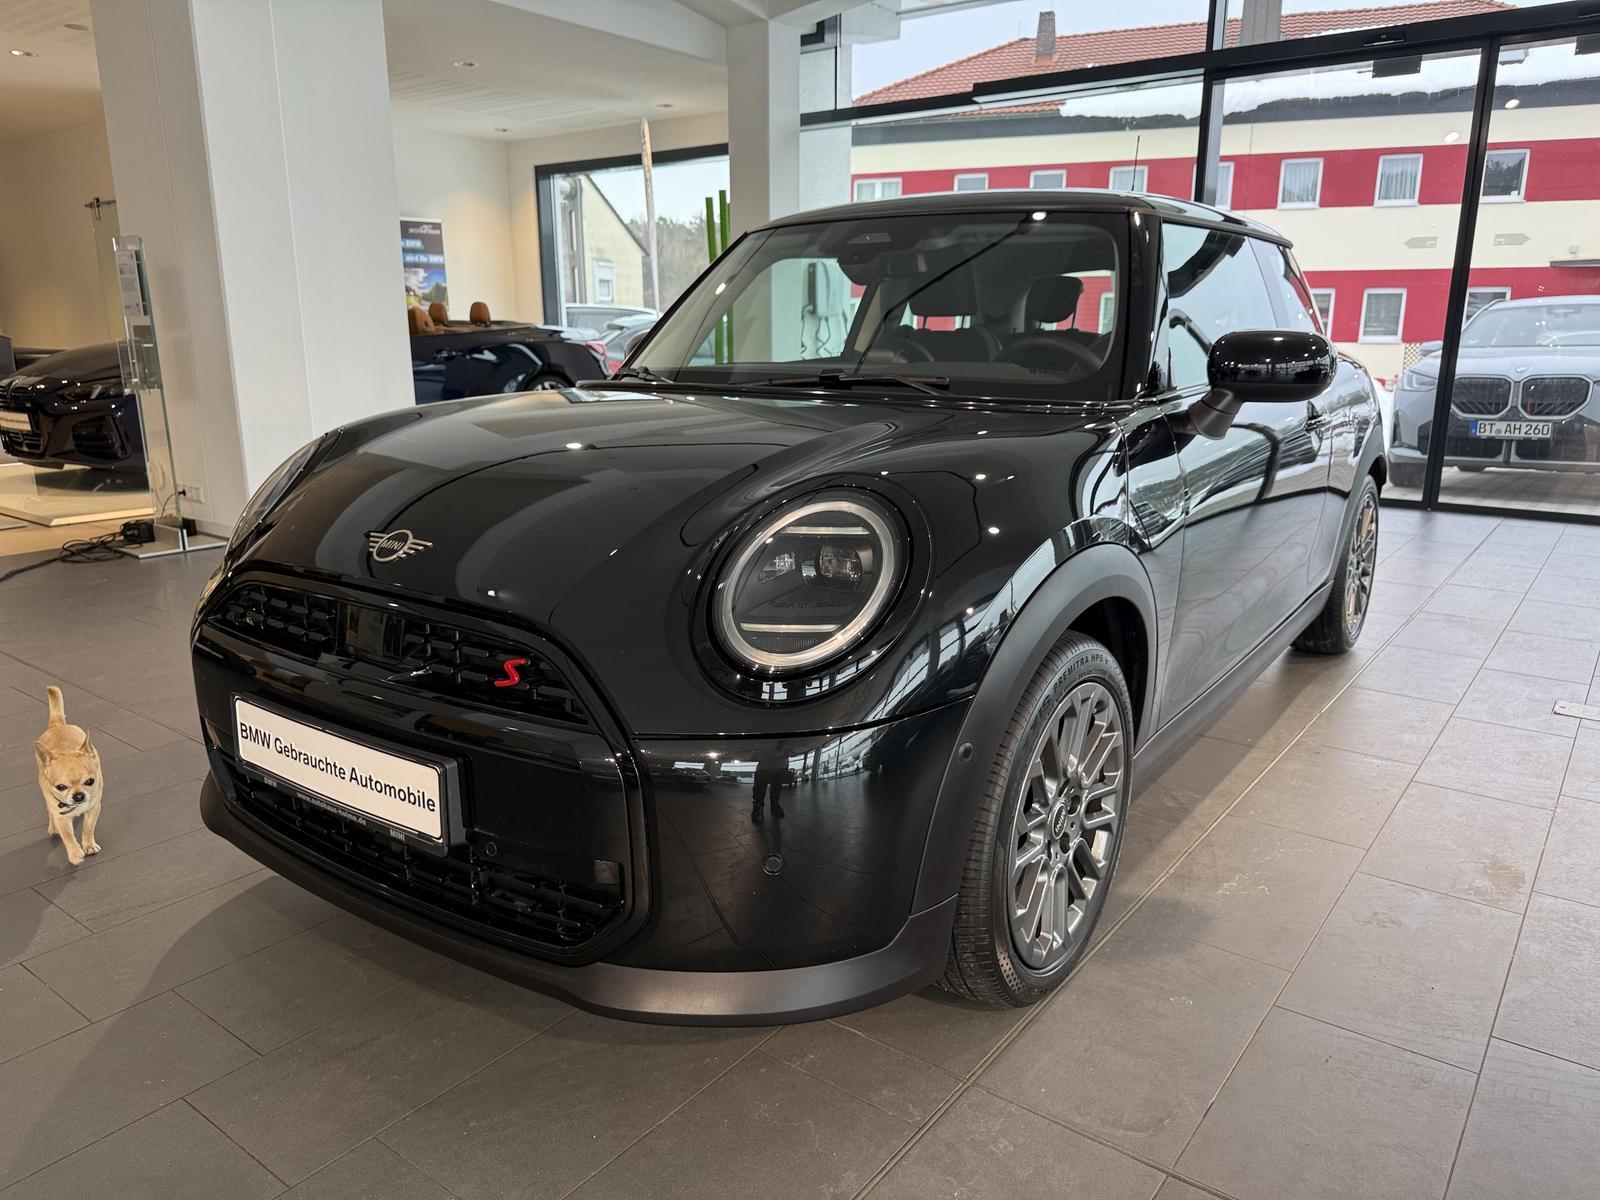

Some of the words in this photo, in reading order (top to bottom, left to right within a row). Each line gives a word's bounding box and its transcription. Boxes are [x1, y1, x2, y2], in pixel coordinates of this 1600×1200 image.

[1478, 422, 1496, 434] BT
[1504, 423, 1522, 435] AH
[1524, 424, 1550, 436] 260
[380, 539, 405, 551] MINI
[494, 657, 530, 688] S
[1053, 655, 1089, 692] PREMITRA
[240, 721, 271, 750] BMW
[274, 737, 346, 781] Gebrauchte
[350, 766, 436, 812] Automobile
